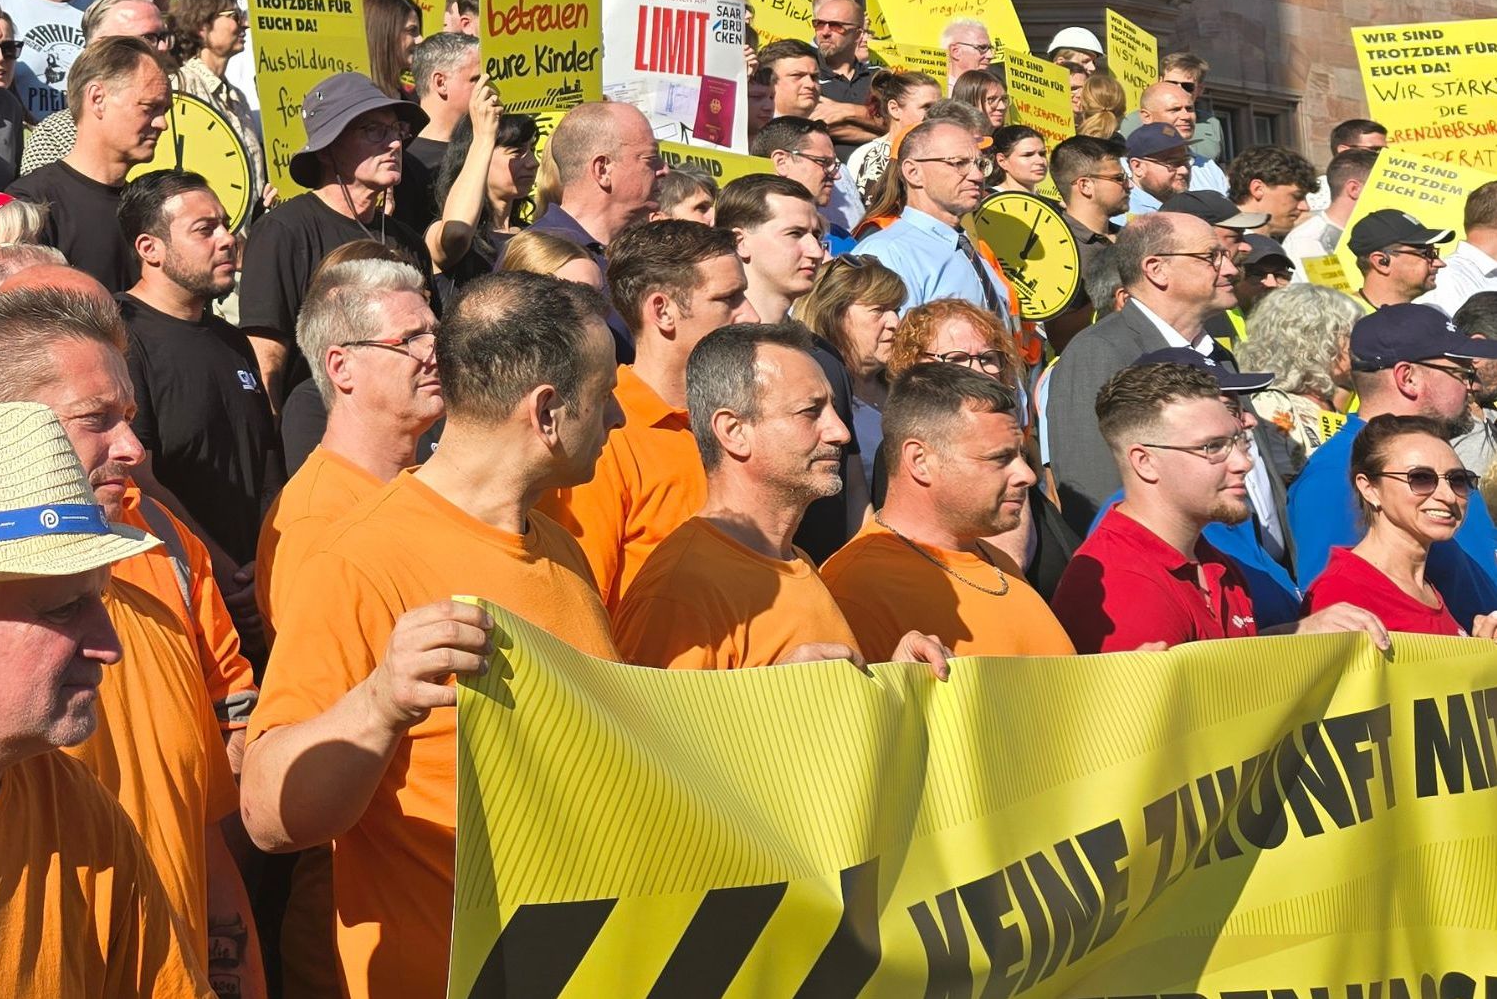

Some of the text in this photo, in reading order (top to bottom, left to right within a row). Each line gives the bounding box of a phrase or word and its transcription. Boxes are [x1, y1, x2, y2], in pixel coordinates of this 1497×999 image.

[257, 16, 318, 32] EUCH DA!
[716, 5, 741, 20] SAAR
[634, 5, 710, 76] LIMIT
[715, 31, 743, 45] CKEN
[1362, 29, 1444, 43] WIR SIND
[486, 39, 599, 82] eure Kinder
[1009, 55, 1043, 73] WIR SIND
[1366, 45, 1462, 60] TROTZDEM
[1010, 67, 1065, 93] TROTZDEM FÜR
[1370, 62, 1451, 77] EUCH DA!
[1012, 80, 1045, 98] EUCH DA!
[1373, 77, 1497, 102] WIR STÄRK
[276, 86, 303, 127] för
[1438, 103, 1469, 117] DIE
[272, 138, 290, 179] fü
[1388, 156, 1458, 179] WIR SIND
[1375, 181, 1446, 205] EUCH DA!
[1382, 169, 1463, 196] TROTZDEM
[906, 703, 1397, 999] KEINE ZUKUNFT
